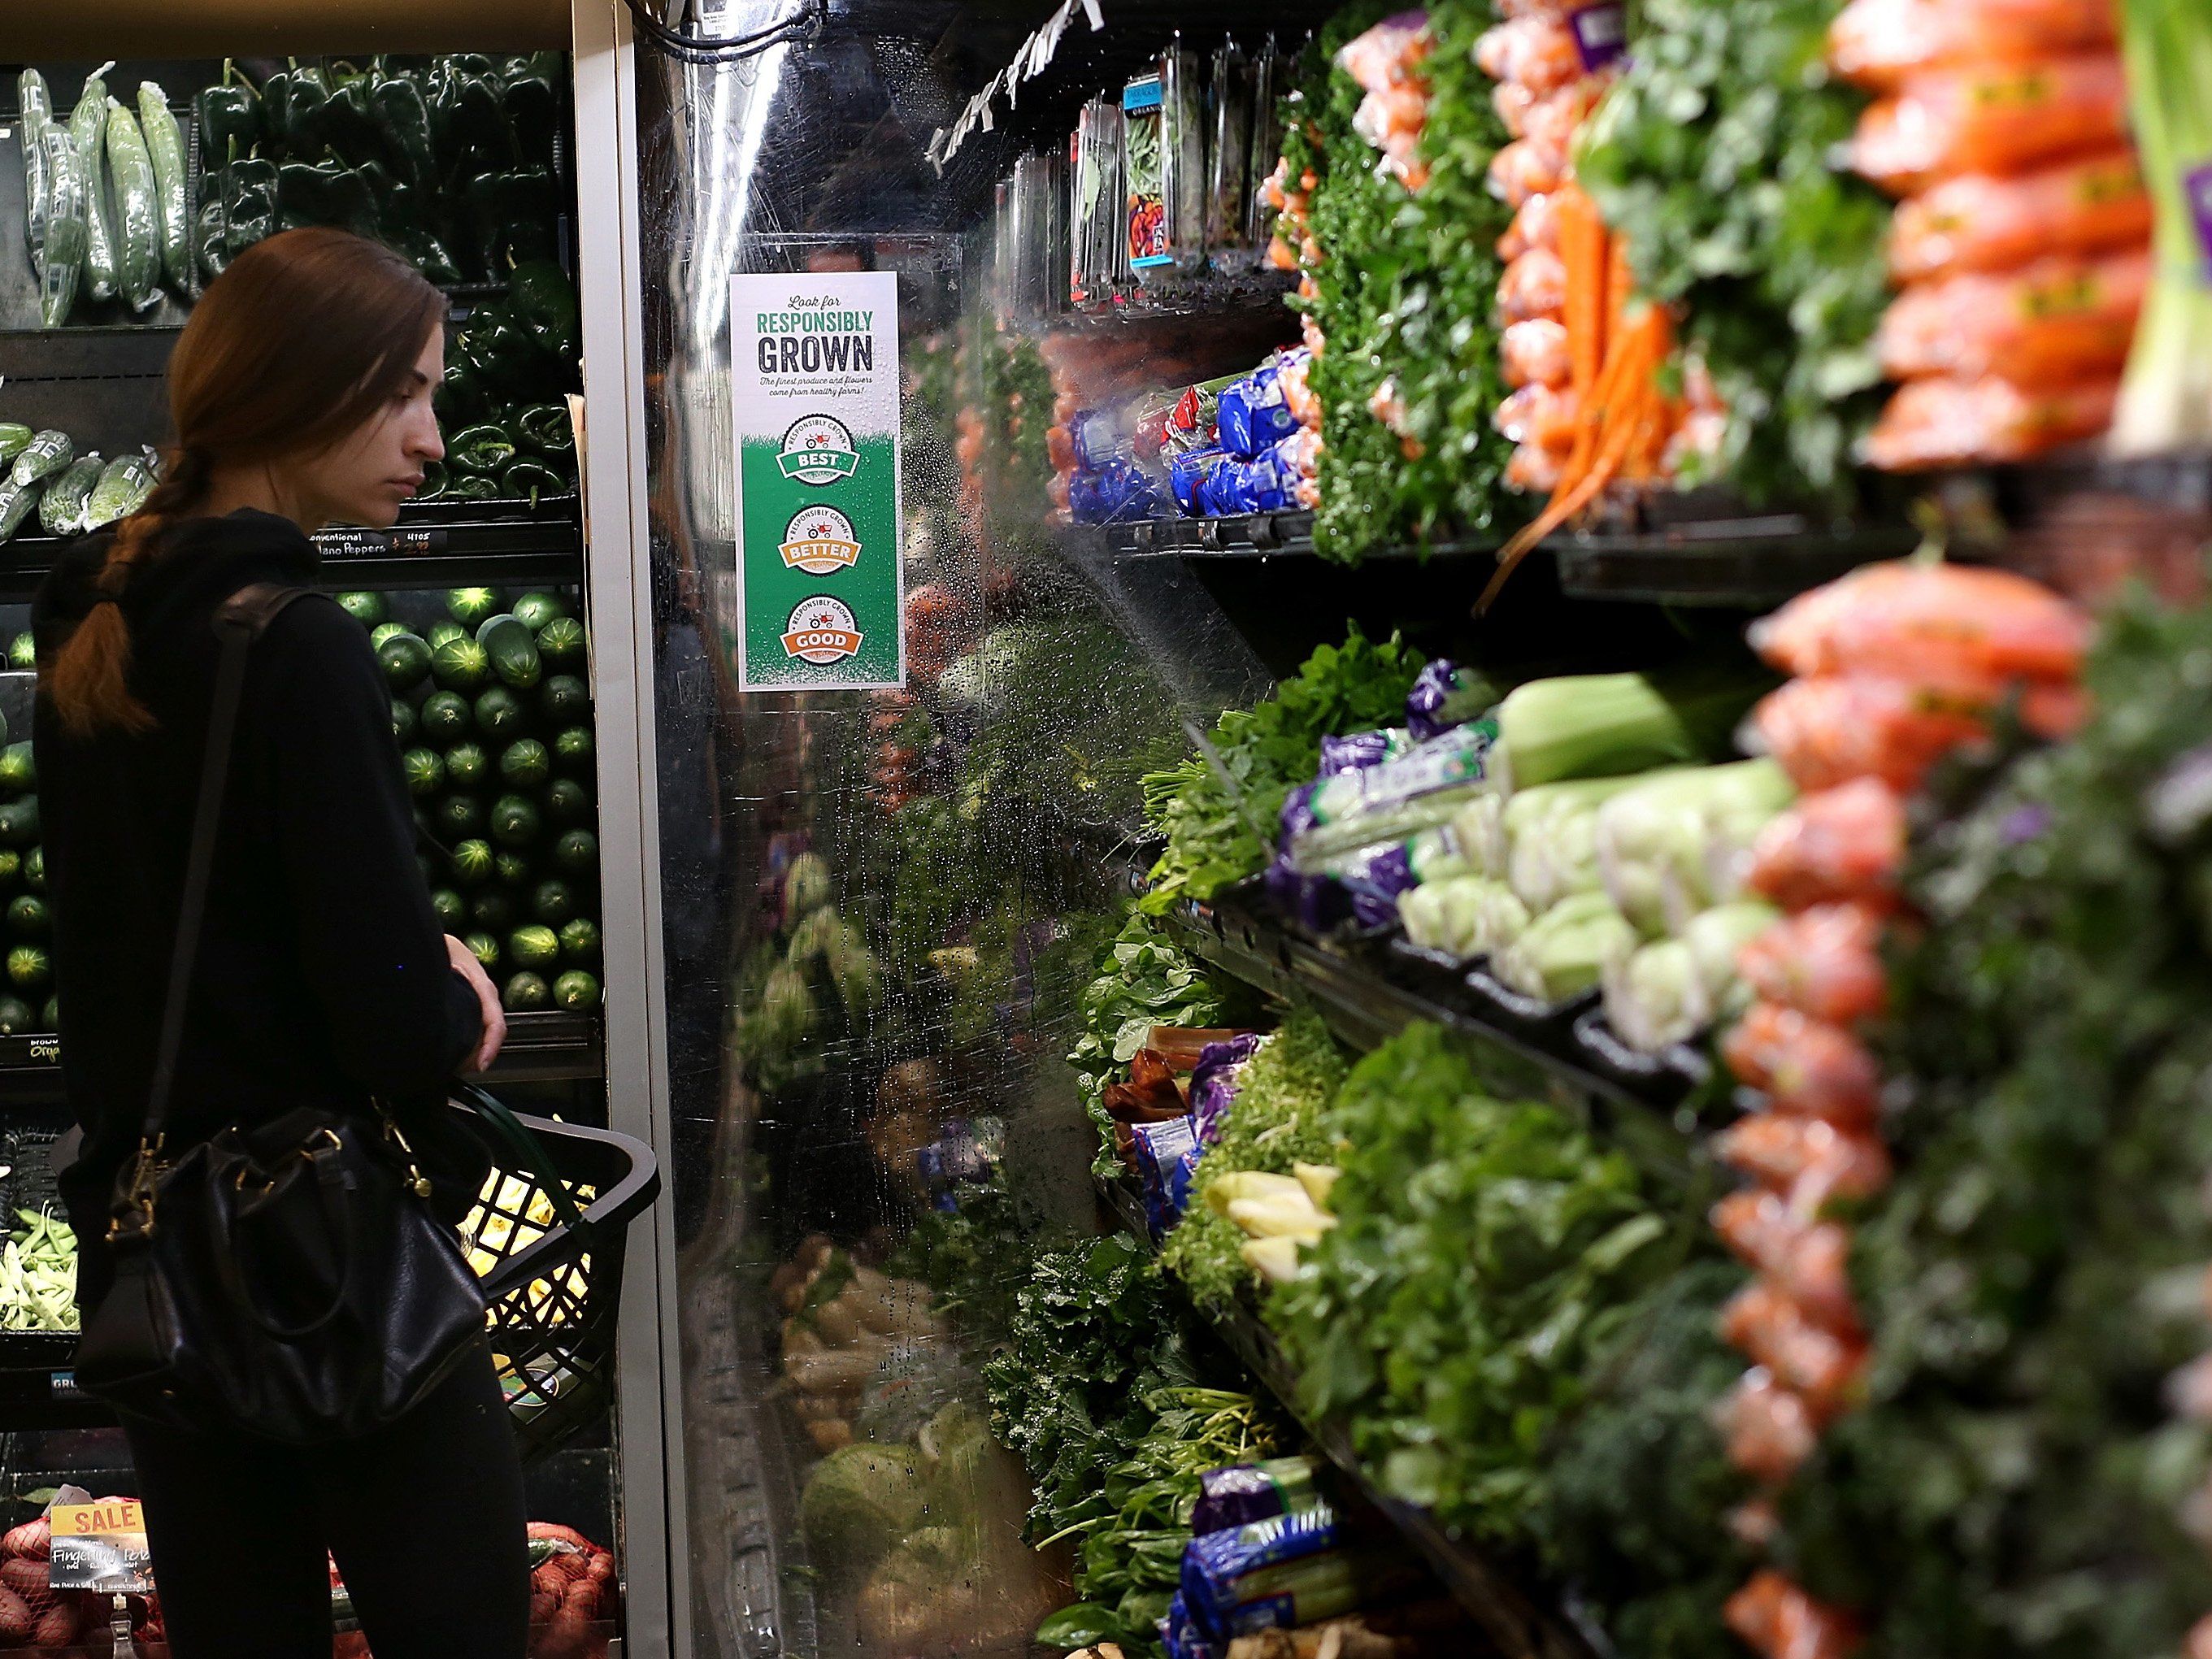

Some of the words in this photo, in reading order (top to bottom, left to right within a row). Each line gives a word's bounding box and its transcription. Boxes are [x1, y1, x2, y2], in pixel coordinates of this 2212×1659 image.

[788, 295, 820, 310] Look
[820, 295, 841, 310] for
[757, 311, 873, 333] RESPONSIBLY
[758, 335, 872, 373] GROWN
[759, 376, 775, 386] The
[776, 376, 797, 387] finest
[797, 376, 828, 387] produce
[829, 376, 844, 384] and
[844, 376, 873, 386] flowers
[789, 388, 809, 397] from
[810, 387, 837, 397] healthy
[837, 387, 865, 397] farms!
[789, 419, 827, 445] RESPONSIBLY
[828, 423, 847, 444] GROWN
[797, 453, 839, 467] BEST
[790, 510, 829, 535] RESPONSIBLY
[830, 513, 850, 534] GROWN
[407, 532, 431, 541] 4105
[318, 544, 341, 555] lano
[344, 541, 387, 556] Peppers
[789, 543, 851, 559] BETTER
[792, 599, 831, 625] RESPONSIBLY
[832, 602, 851, 623] GROWN
[796, 632, 847, 647] GOOD
[30, 1046, 60, 1063] Orga
[75, 1505, 136, 1533] SALE
[124, 1547, 150, 1561] Pota
